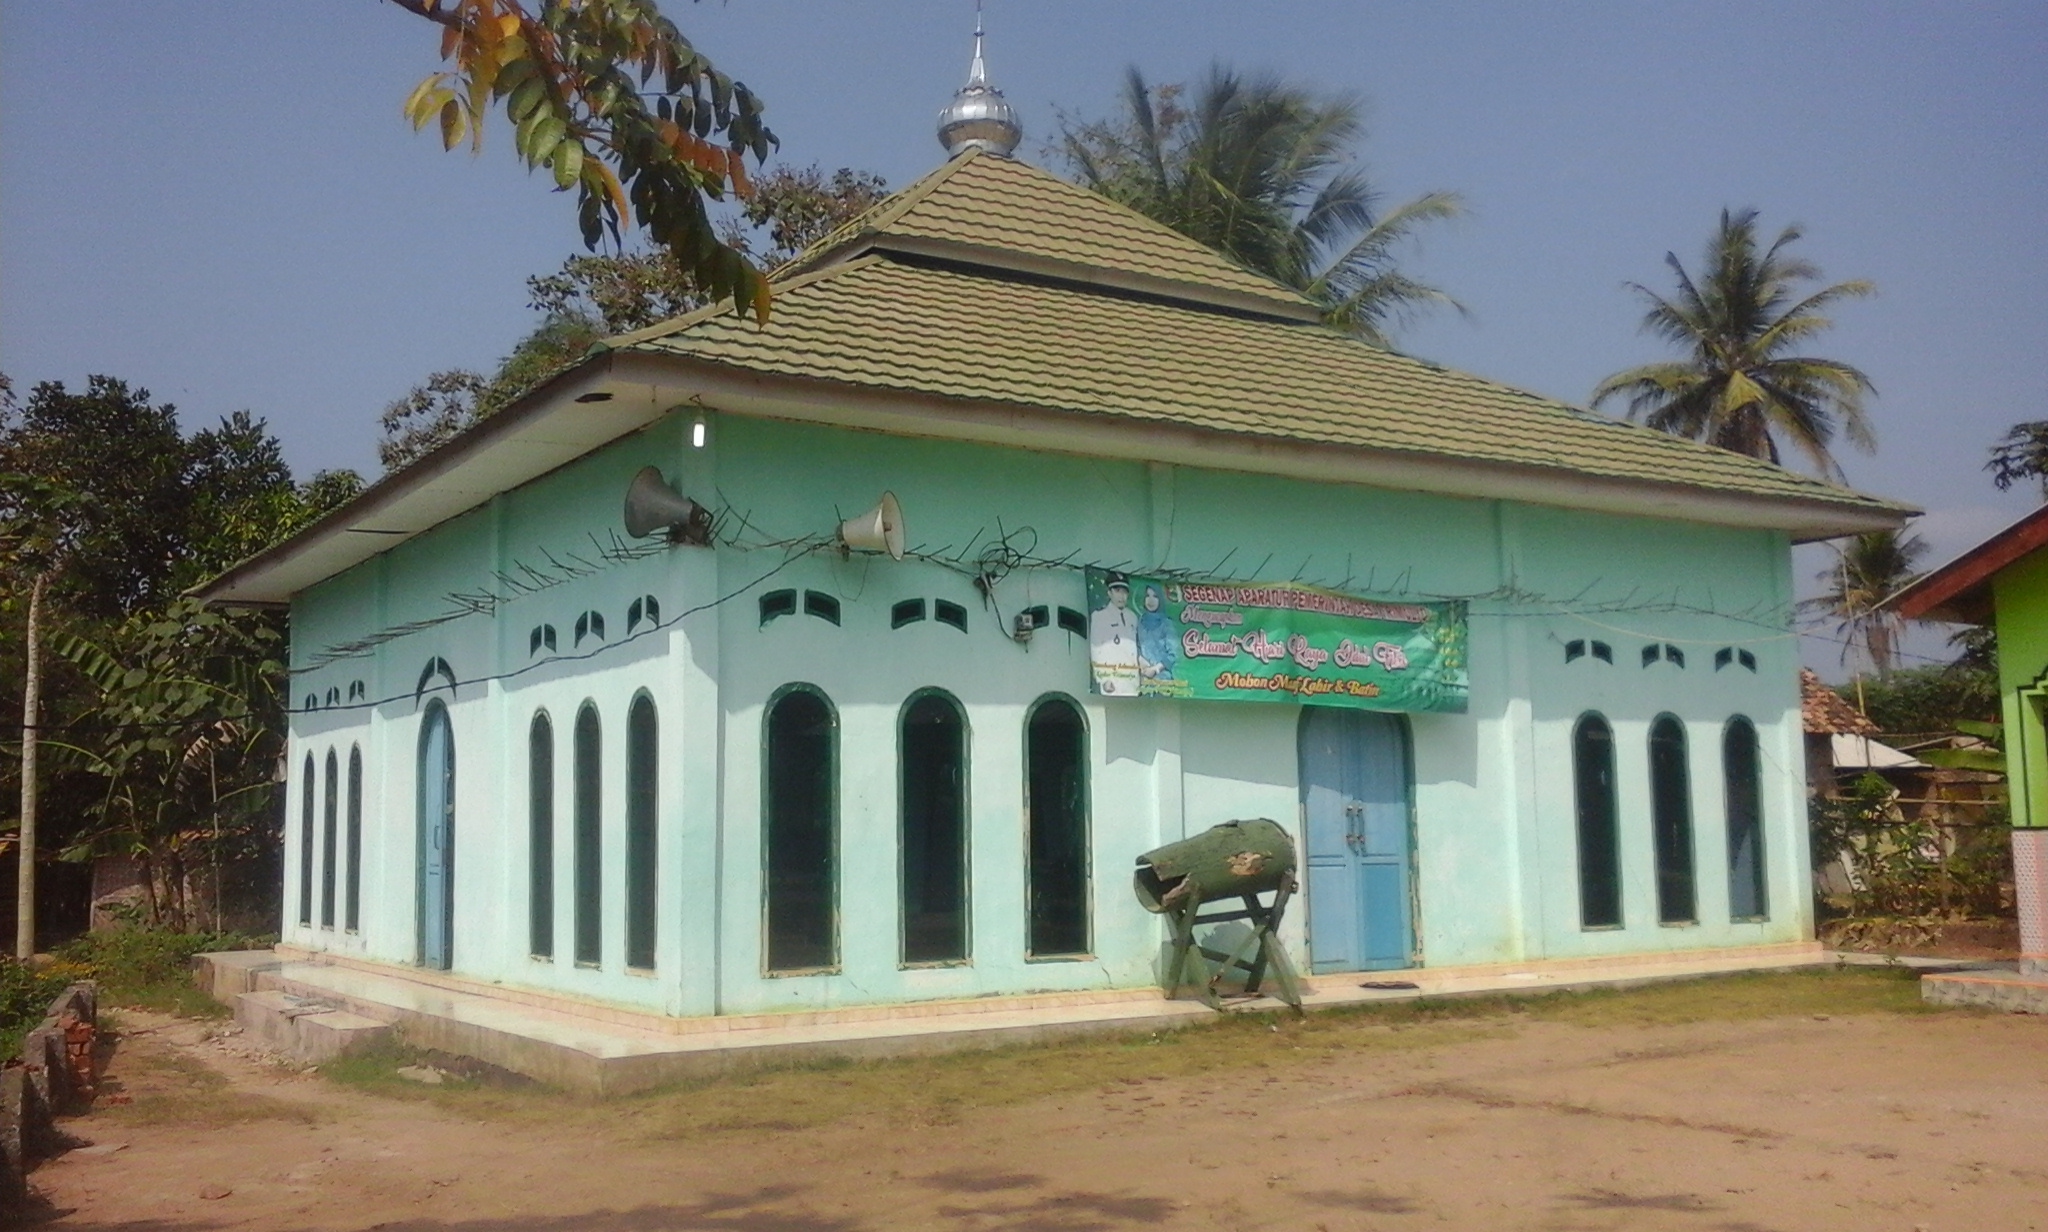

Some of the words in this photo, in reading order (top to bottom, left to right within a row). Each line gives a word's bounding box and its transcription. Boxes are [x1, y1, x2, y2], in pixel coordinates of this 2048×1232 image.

[1183, 585, 1235, 604] SEGENAP
[1182, 629, 1240, 657] Selamat
[1240, 628, 1286, 664] Hari
[1287, 633, 1329, 671] Raya
[1215, 672, 1269, 690] Mohon
[1299, 676, 1333, 695] Lahir
[1333, 679, 1345, 693] &
[1347, 680, 1380, 697] Batin
